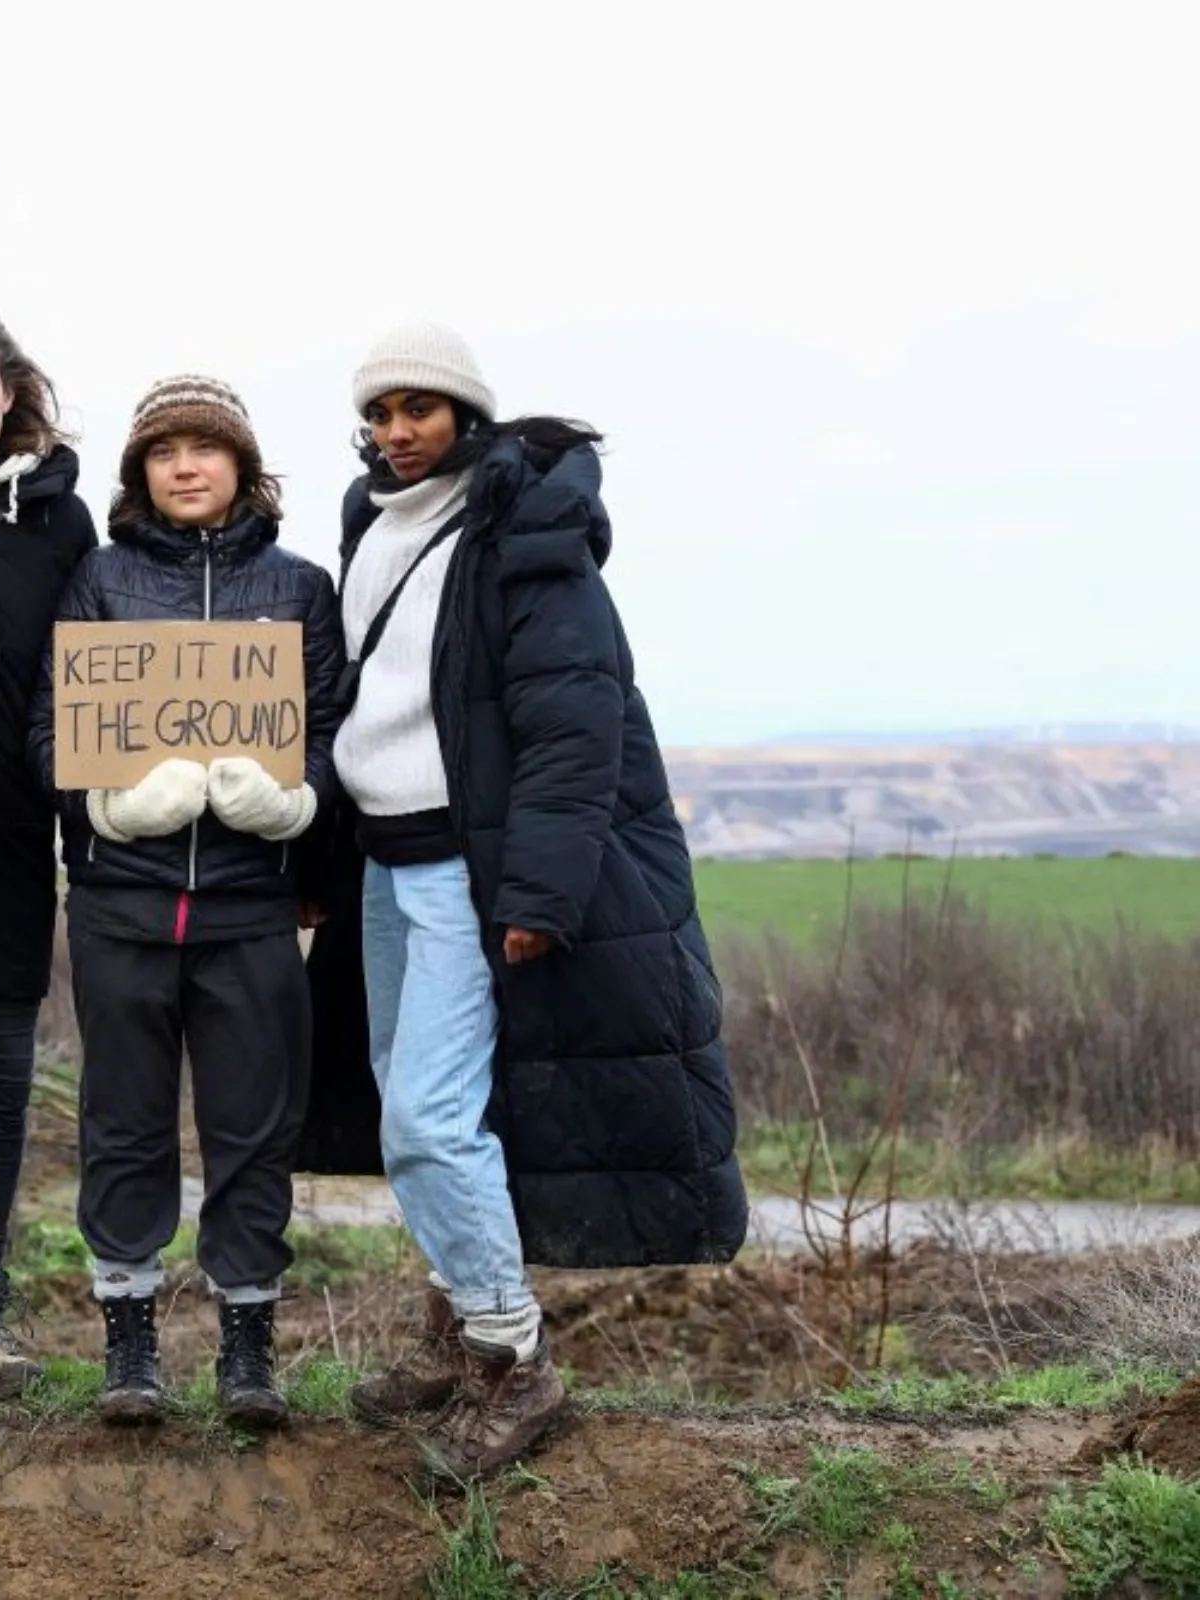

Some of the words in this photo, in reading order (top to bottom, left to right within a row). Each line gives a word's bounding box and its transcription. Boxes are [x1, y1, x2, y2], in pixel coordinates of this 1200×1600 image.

[63, 642, 157, 687] KEEP
[174, 641, 217, 681] IT
[232, 644, 277, 682] IN
[62, 700, 150, 755] THE
[155, 698, 301, 752] GROUND
